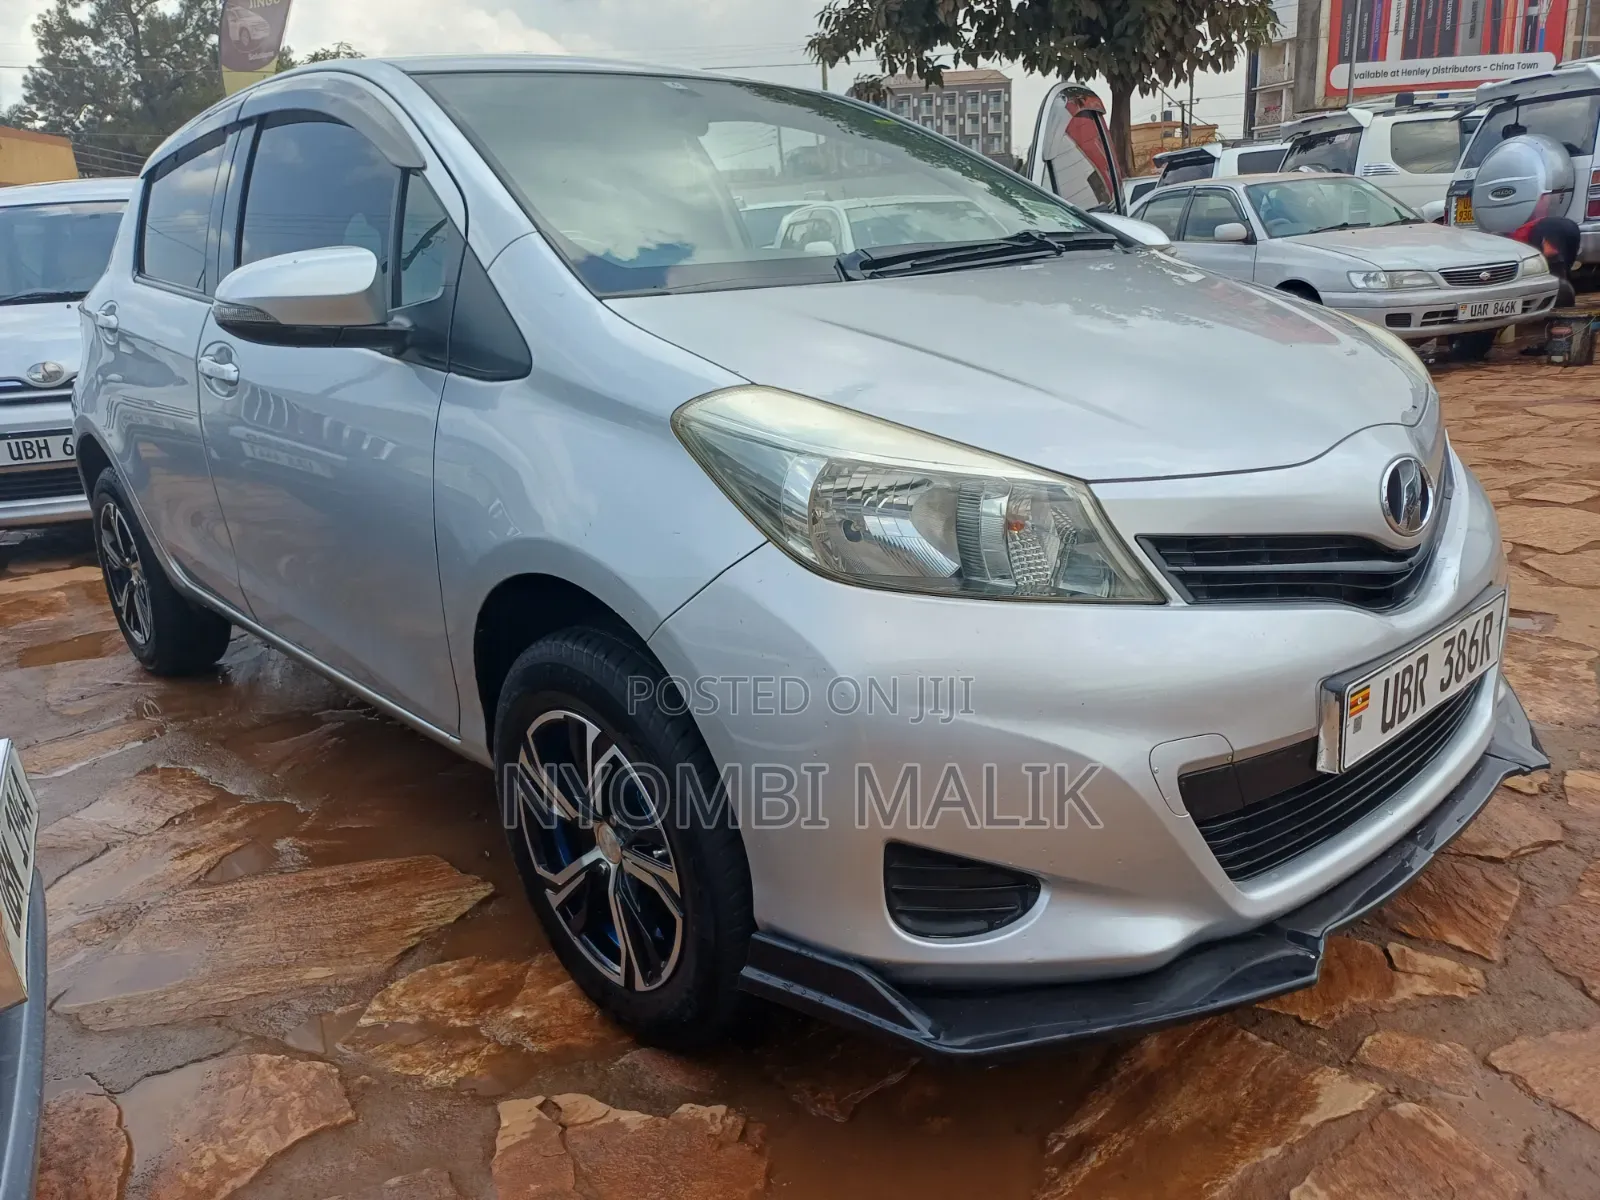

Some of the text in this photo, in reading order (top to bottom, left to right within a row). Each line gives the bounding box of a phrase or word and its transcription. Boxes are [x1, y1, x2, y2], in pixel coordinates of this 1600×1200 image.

[1349, 68, 1389, 80] vailable
[1390, 70, 1400, 78] at
[1401, 68, 1431, 78] Henley
[1432, 64, 1482, 75] Distributors
[1490, 62, 1515, 72] China
[1517, 61, 1539, 70] Town
[1470, 301, 1517, 317] UAR 846K
[7, 438, 51, 461] UBH
[1381, 611, 1494, 734] UBR 386R
